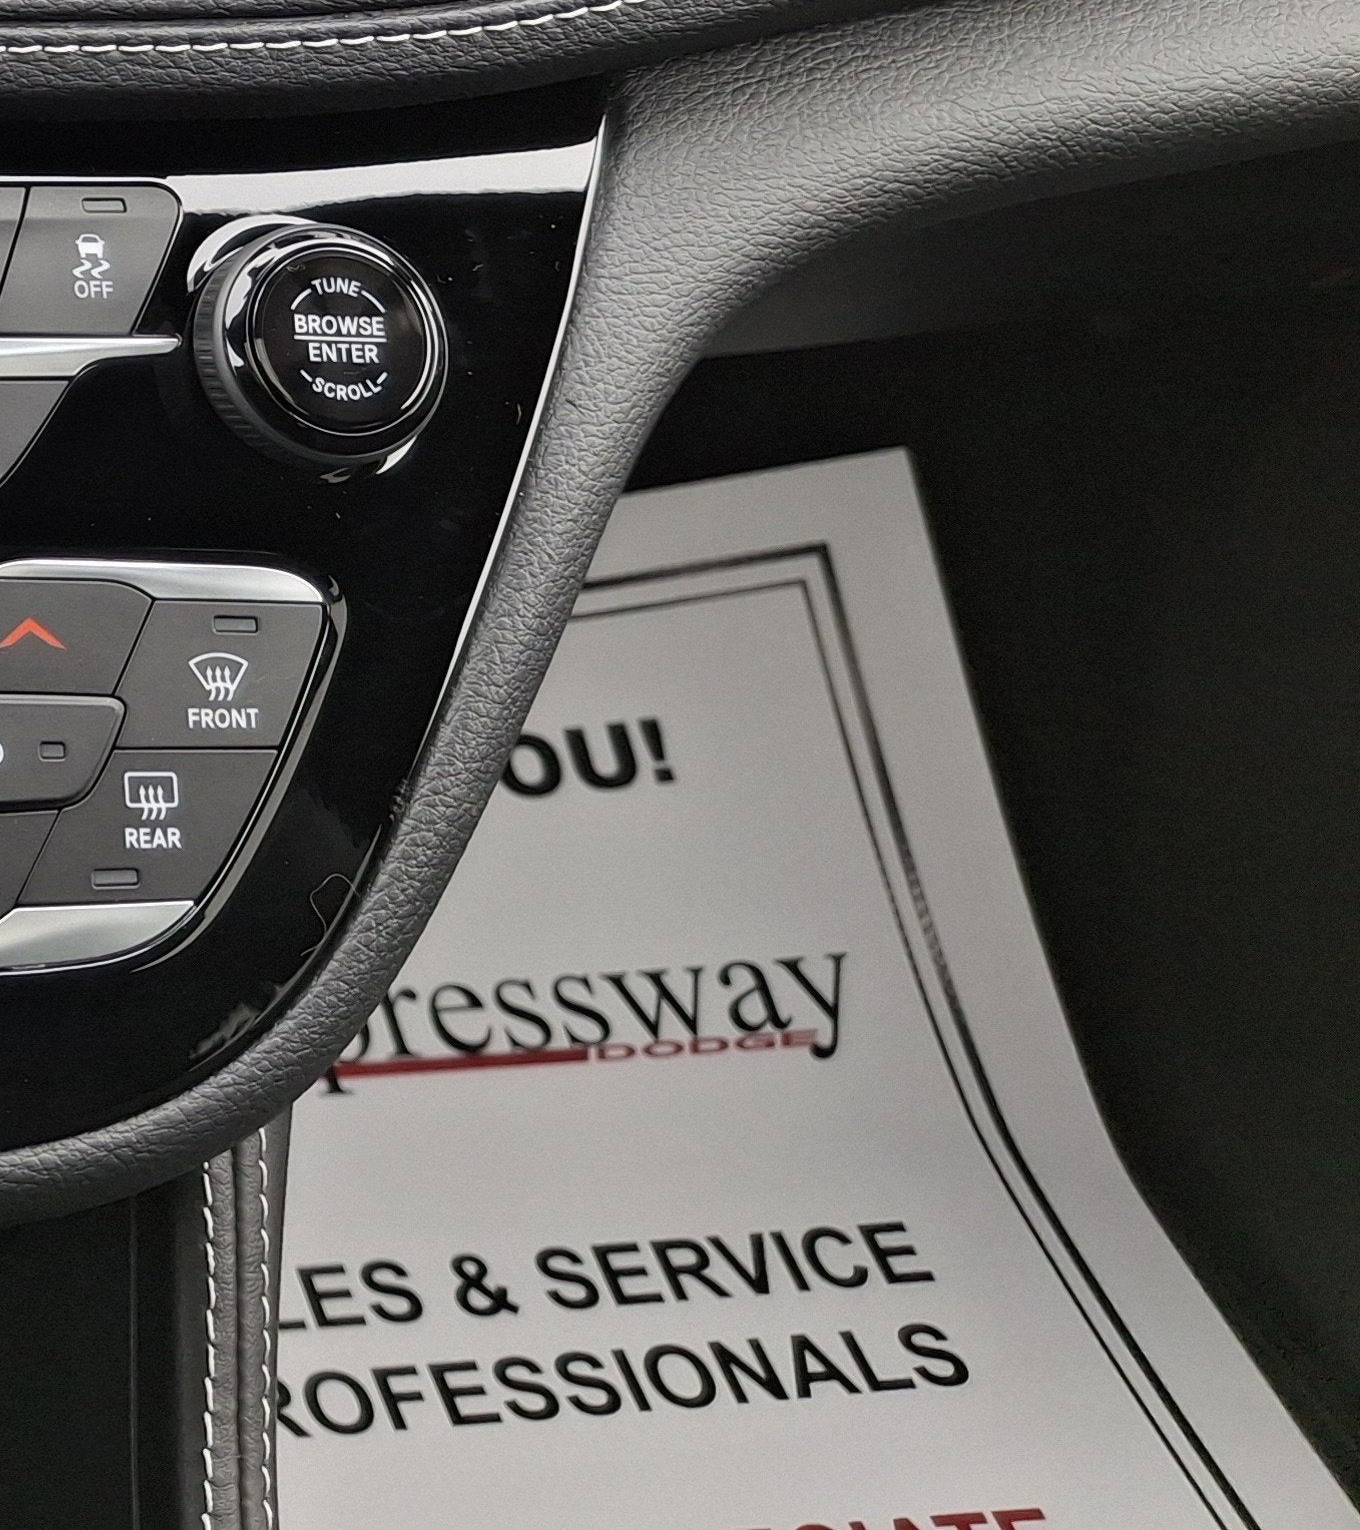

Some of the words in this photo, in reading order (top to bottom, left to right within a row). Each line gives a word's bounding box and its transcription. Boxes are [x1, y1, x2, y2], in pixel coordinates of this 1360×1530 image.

[74, 276, 114, 299] OFF
[313, 276, 361, 299] TUNE
[293, 313, 386, 338] BROWSE
[307, 341, 381, 366] ENTER
[312, 376, 382, 401] SCROLL
[187, 707, 259, 729] FRONT
[121, 827, 184, 852] REAR
[592, 1027, 818, 1062] DODGE
[279, 1258, 424, 1330] ES
[451, 1254, 520, 1317] &
[535, 1221, 936, 1310] SERVICE
